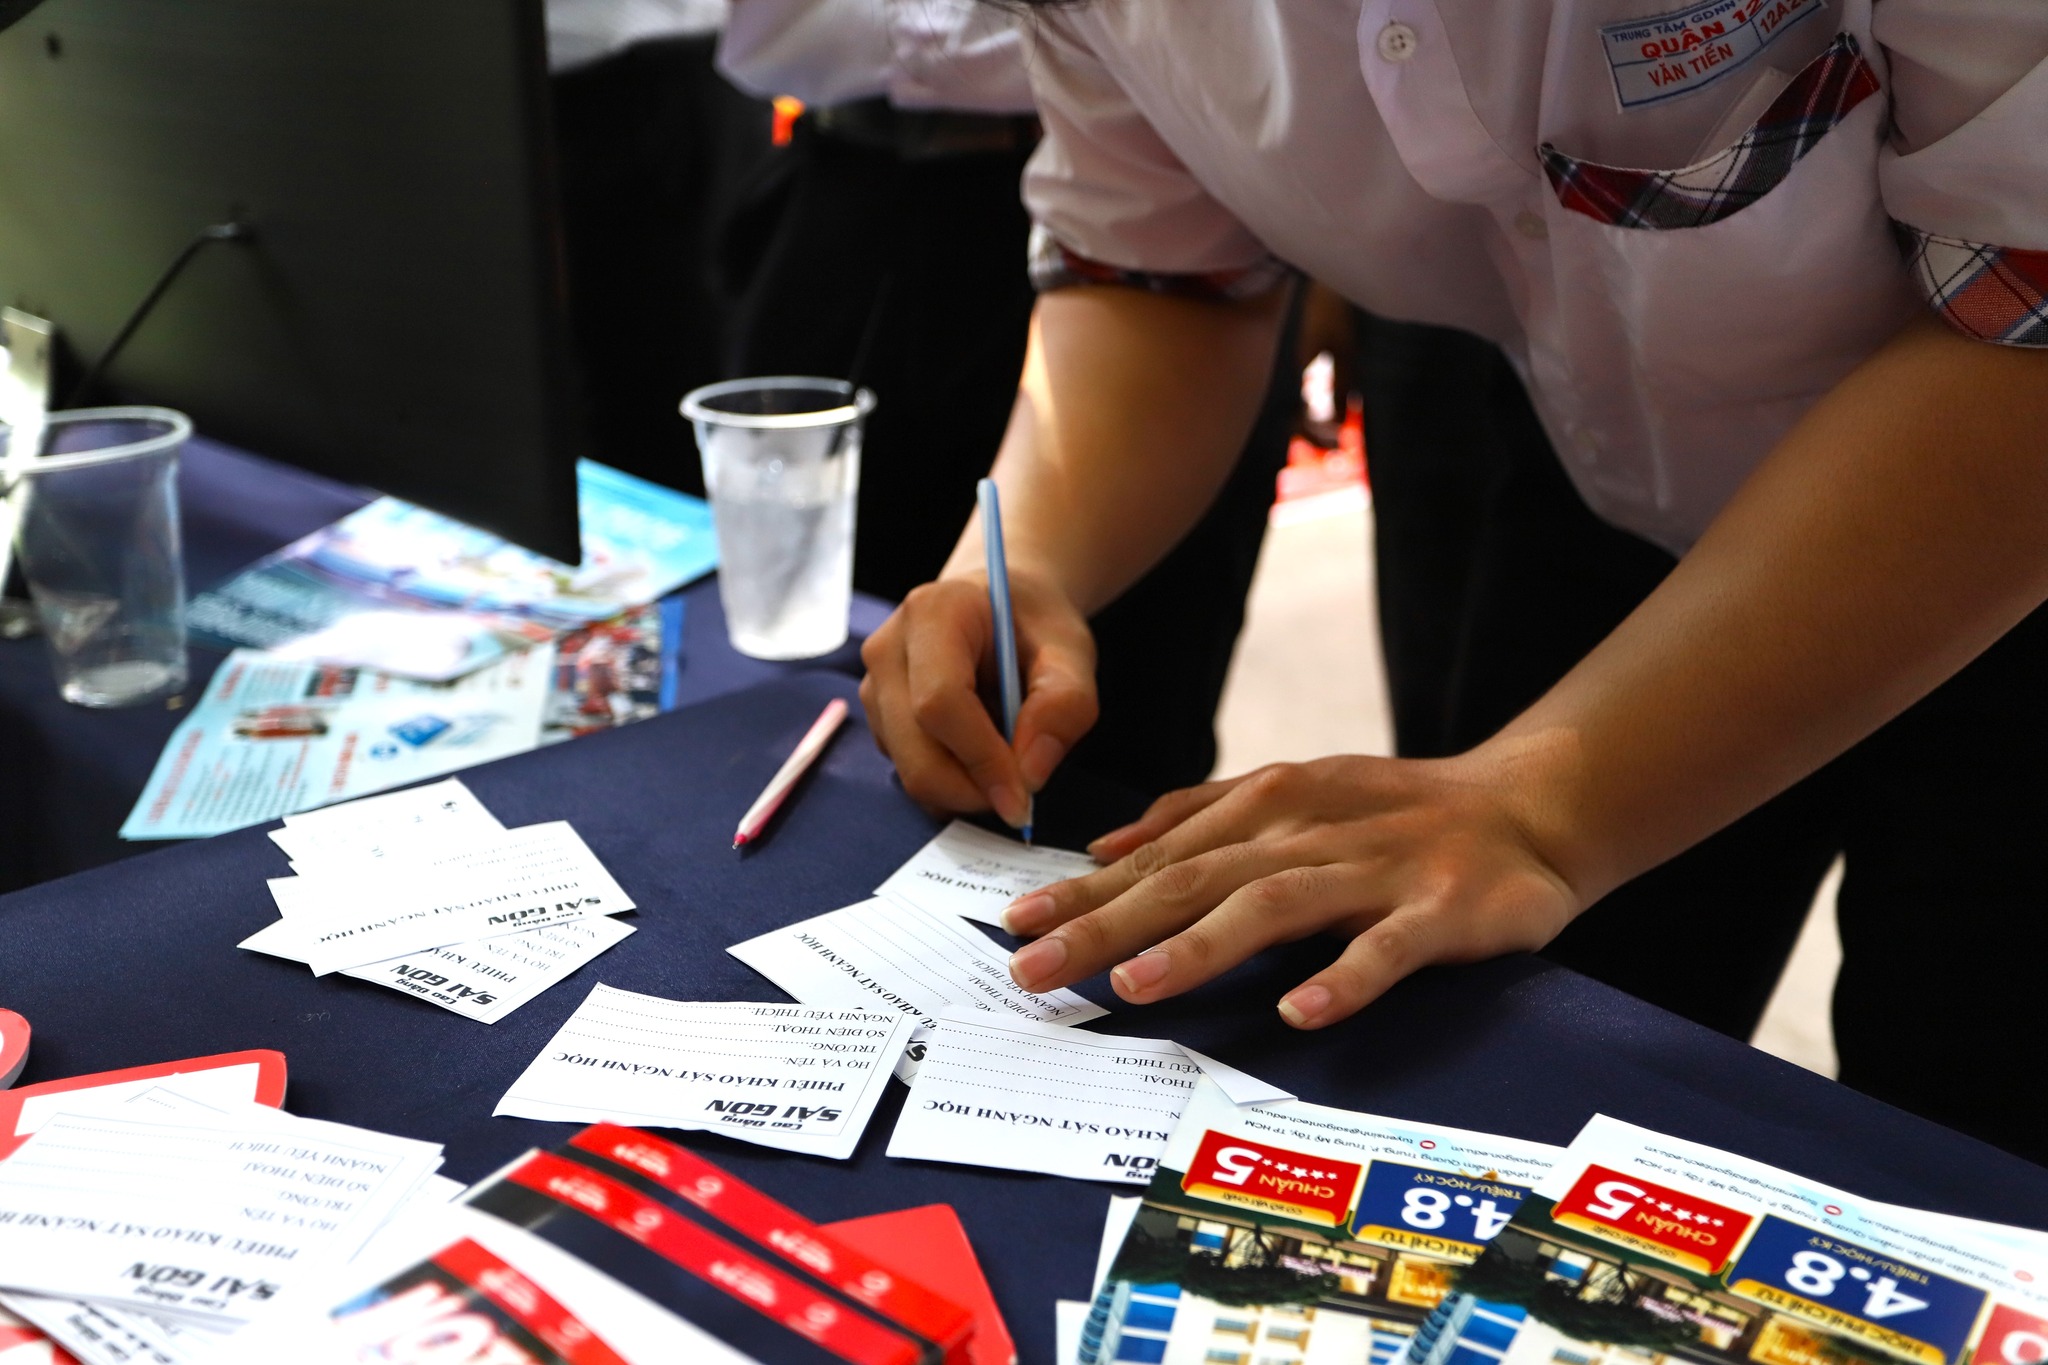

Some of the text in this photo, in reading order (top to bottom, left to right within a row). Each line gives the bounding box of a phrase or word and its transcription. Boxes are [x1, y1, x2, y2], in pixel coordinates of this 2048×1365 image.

[1612, 1, 1736, 43] TRUNG TÂM GDNN
[1760, 0, 1808, 33] 12A2
[1641, 20, 1725, 59] QUẬN
[1648, 42, 1734, 87] VĂN TIẾN
[917, 871, 953, 887] HỌC
[956, 881, 1014, 898] NGÀNH
[793, 933, 823, 950] HỌC
[818, 948, 864, 978] NGÀNH
[389, 964, 497, 1006] SÀI GÒN
[857, 977, 886, 995] SÁT
[804, 1010, 834, 1020] YÊU
[840, 1012, 894, 1023] NGÀNH
[826, 1026, 862, 1038] ĐIỆN
[866, 1030, 887, 1039] SỐ
[552, 1052, 845, 1092] PHIẾU KHẢO SÁT NGÀNH HỌC
[823, 1059, 842, 1069] VÀ
[847, 1060, 870, 1070] HỌ
[704, 1099, 842, 1122] SÀI GÒN
[771, 1122, 803, 1131] Cao
[922, 1100, 1169, 1142] KHẢO SÁT NGÀNH HỌC
[1244, 1119, 1271, 1133] HCM
[1272, 1126, 1286, 1135] TP
[1314, 1133, 1331, 1145] Mỹ
[1333, 1137, 1367, 1152] Trung
[1103, 1153, 1158, 1172] ÒN
[1211, 1146, 1263, 1186] 5
[1420, 1153, 1461, 1167] Quang
[1125, 1170, 1150, 1180] ng
[1411, 1172, 1436, 1185] KỲ
[1258, 1173, 1335, 1199] CHUẨN
[1585, 1181, 1647, 1221] 5
[1400, 1187, 1513, 1241] 4.8
[1635, 1211, 1717, 1246] CHUẨN
[120, 1262, 207, 1290] GÒN
[1785, 1251, 1930, 1319] 4.8
